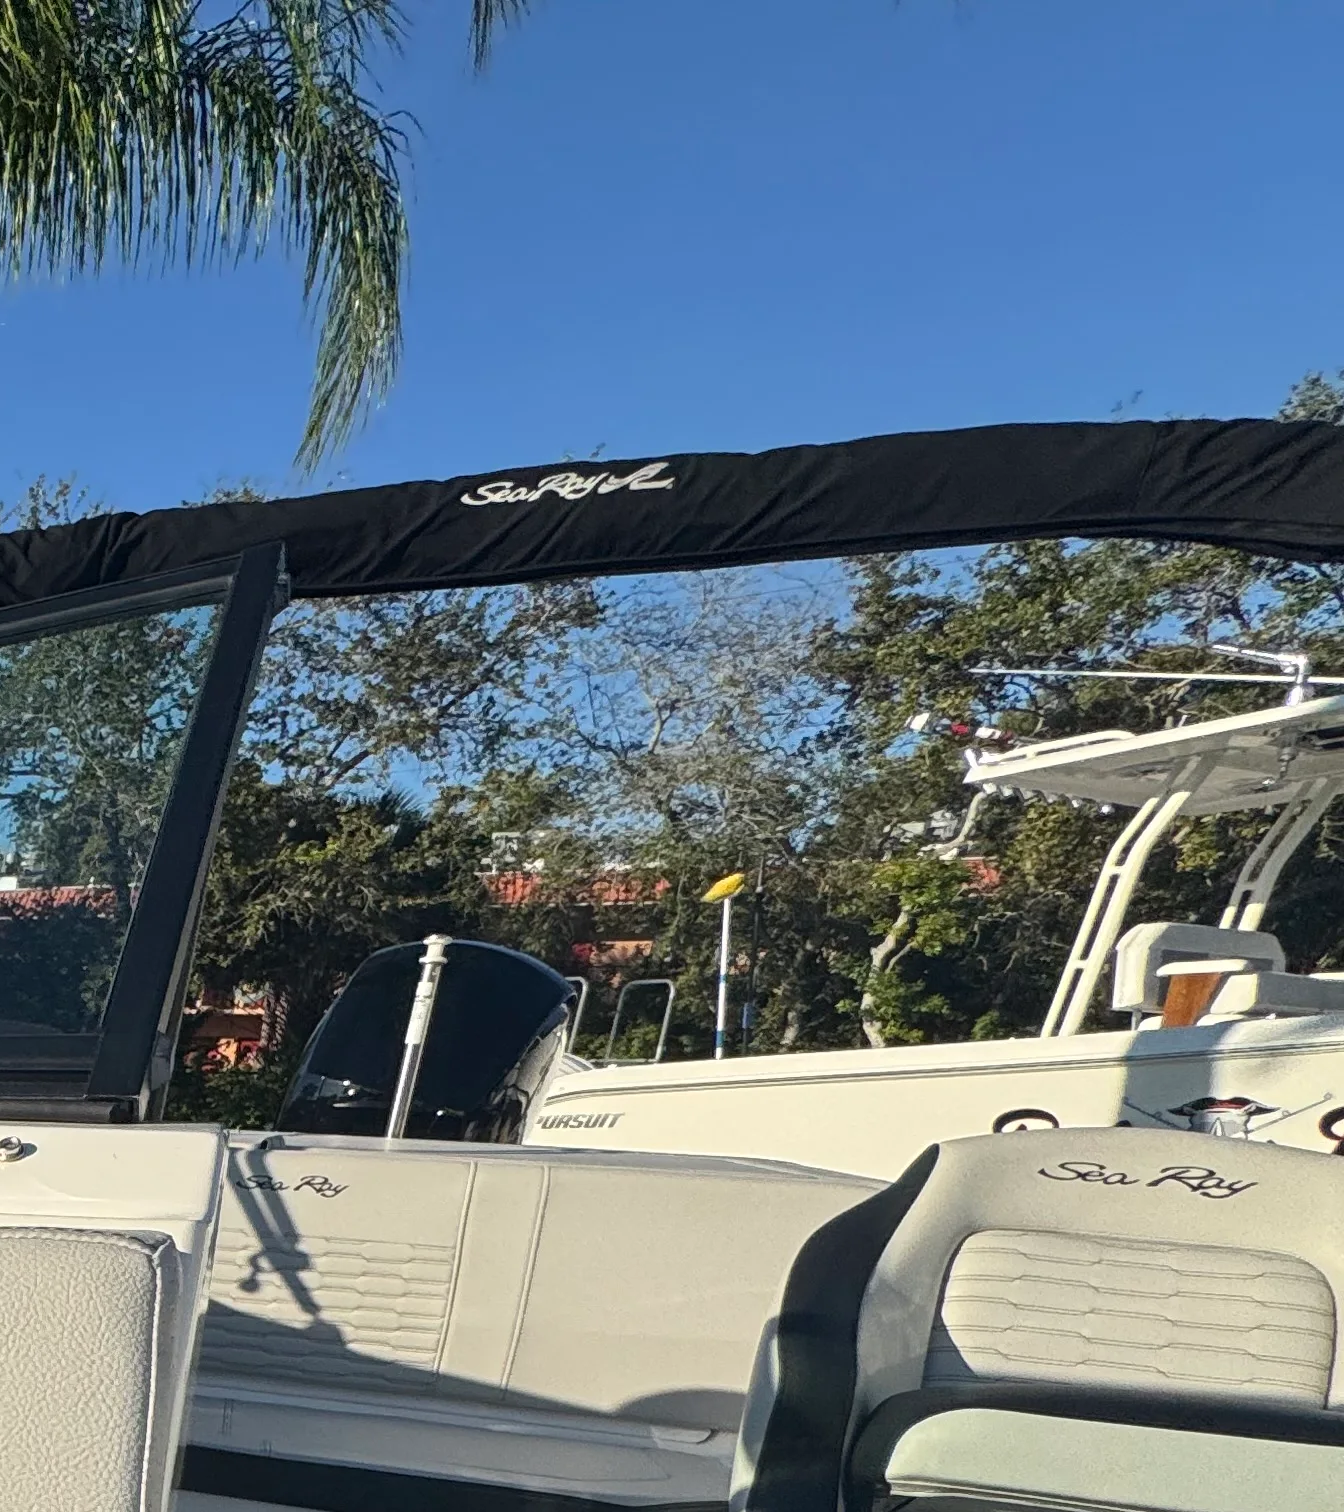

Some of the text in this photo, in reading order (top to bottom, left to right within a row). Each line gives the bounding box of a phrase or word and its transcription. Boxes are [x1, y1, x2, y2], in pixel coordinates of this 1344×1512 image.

[461, 472, 610, 506] Sea Ray
[236, 1174, 350, 1198] Sea Ray
[1037, 1161, 1259, 1199] Sea Ray
